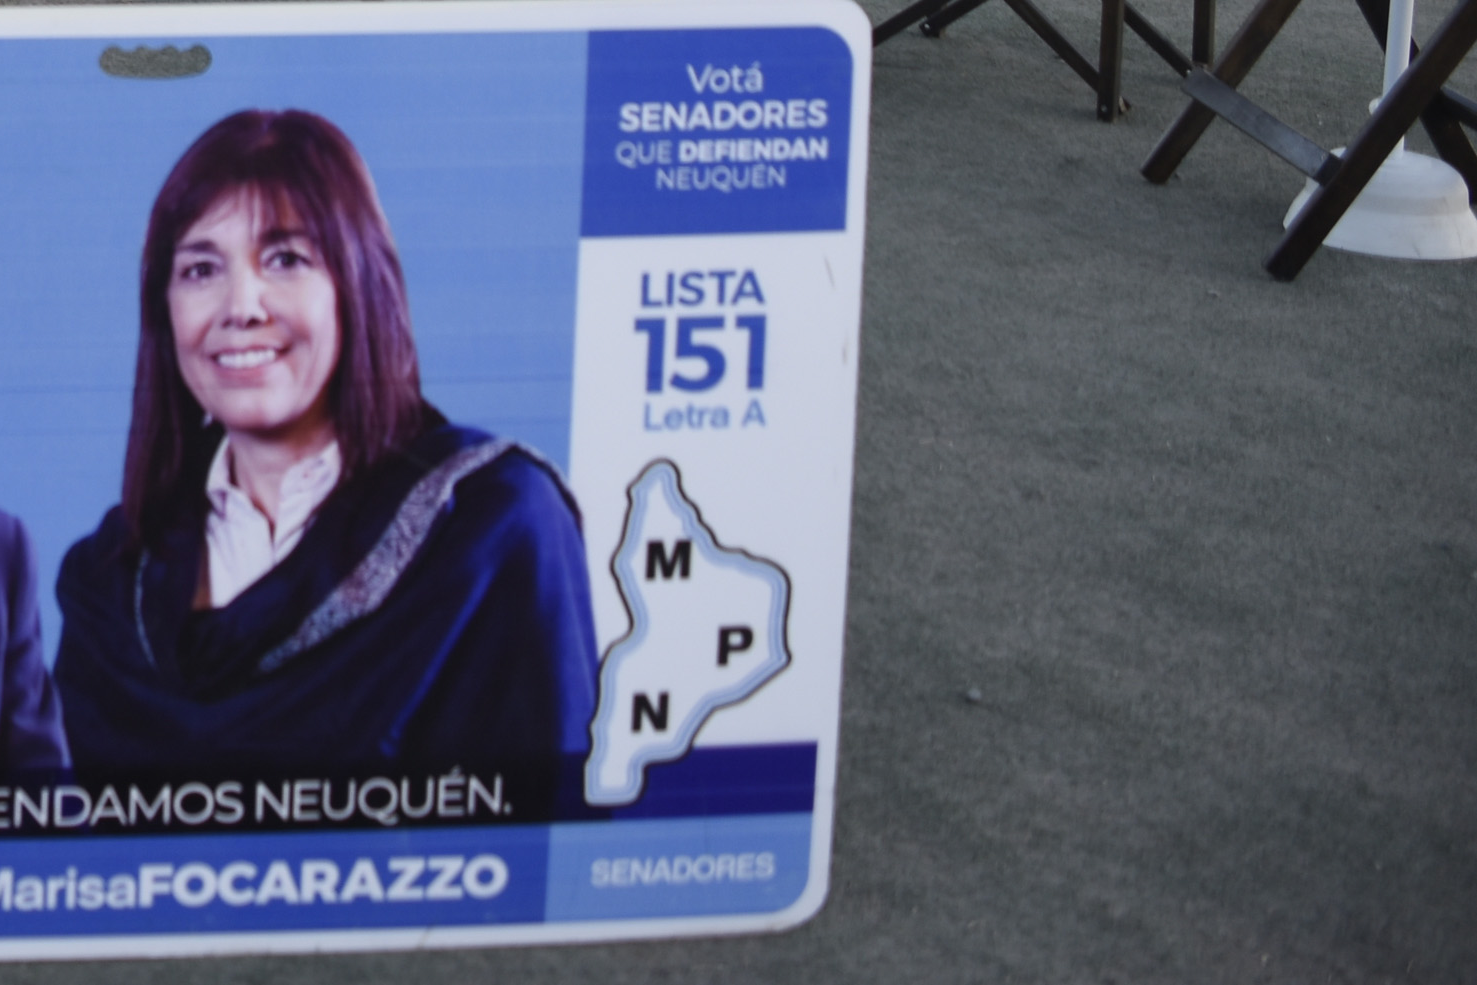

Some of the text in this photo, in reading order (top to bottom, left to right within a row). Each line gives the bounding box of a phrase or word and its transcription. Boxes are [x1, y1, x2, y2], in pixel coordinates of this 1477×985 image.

[686, 61, 764, 94] Votá
[619, 98, 829, 133] SENADORES
[615, 137, 829, 168] QUE DEFIENDAN
[655, 163, 787, 192] NEUQUÉN
[640, 269, 765, 308] LISTA
[634, 314, 767, 394] 151
[643, 397, 766, 433] Letra A
[645, 539, 692, 582] M
[716, 625, 754, 668] P
[631, 691, 670, 734] N
[255, 765, 512, 825] NEUQUÉN.
[591, 852, 775, 888] SENADORES
